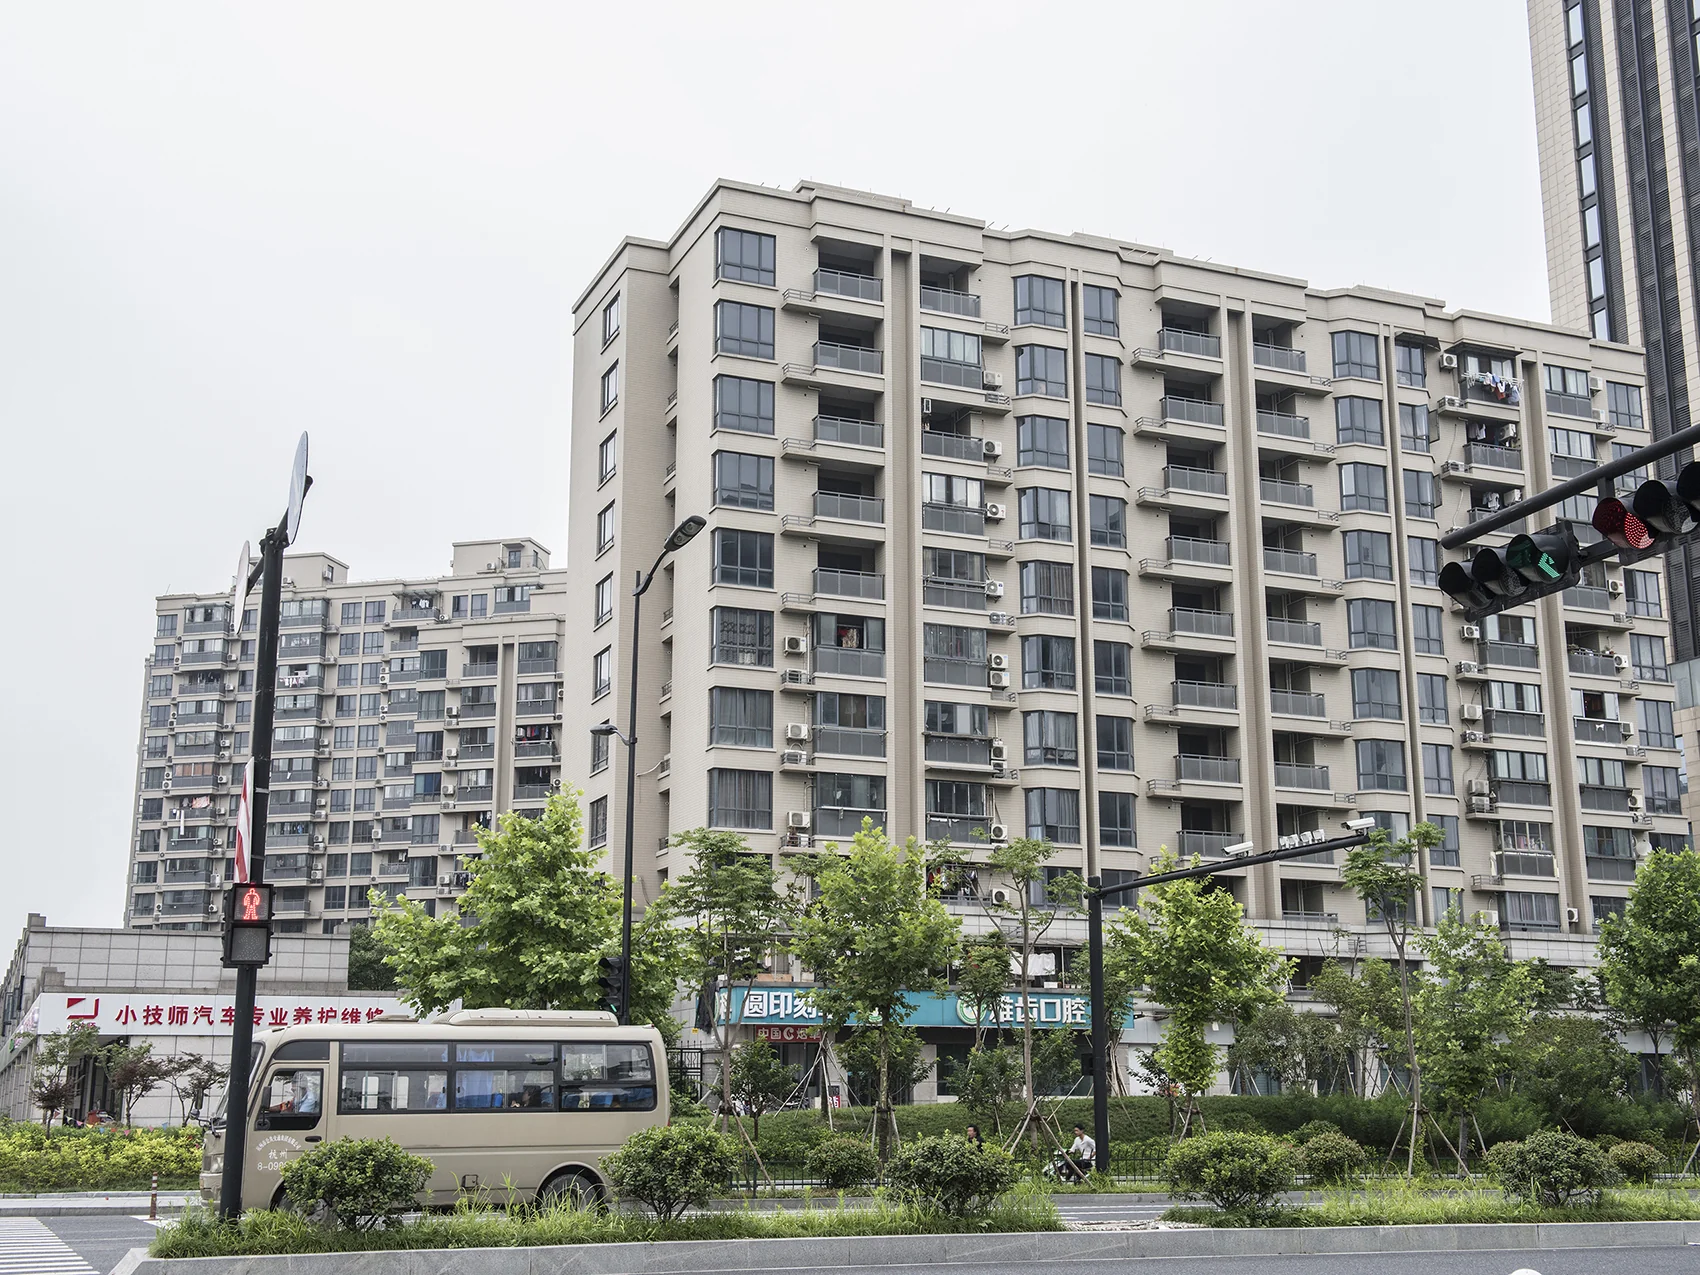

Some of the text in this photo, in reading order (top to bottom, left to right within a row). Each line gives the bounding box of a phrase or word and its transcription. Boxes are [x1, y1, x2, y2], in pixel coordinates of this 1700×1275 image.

[743, 990, 835, 1019] 圆印刻
[114, 1004, 384, 1027] 小技师汽车专业养护维修
[268, 1148, 288, 1160] 杭州
[256, 1161, 287, 1171] 8-09
